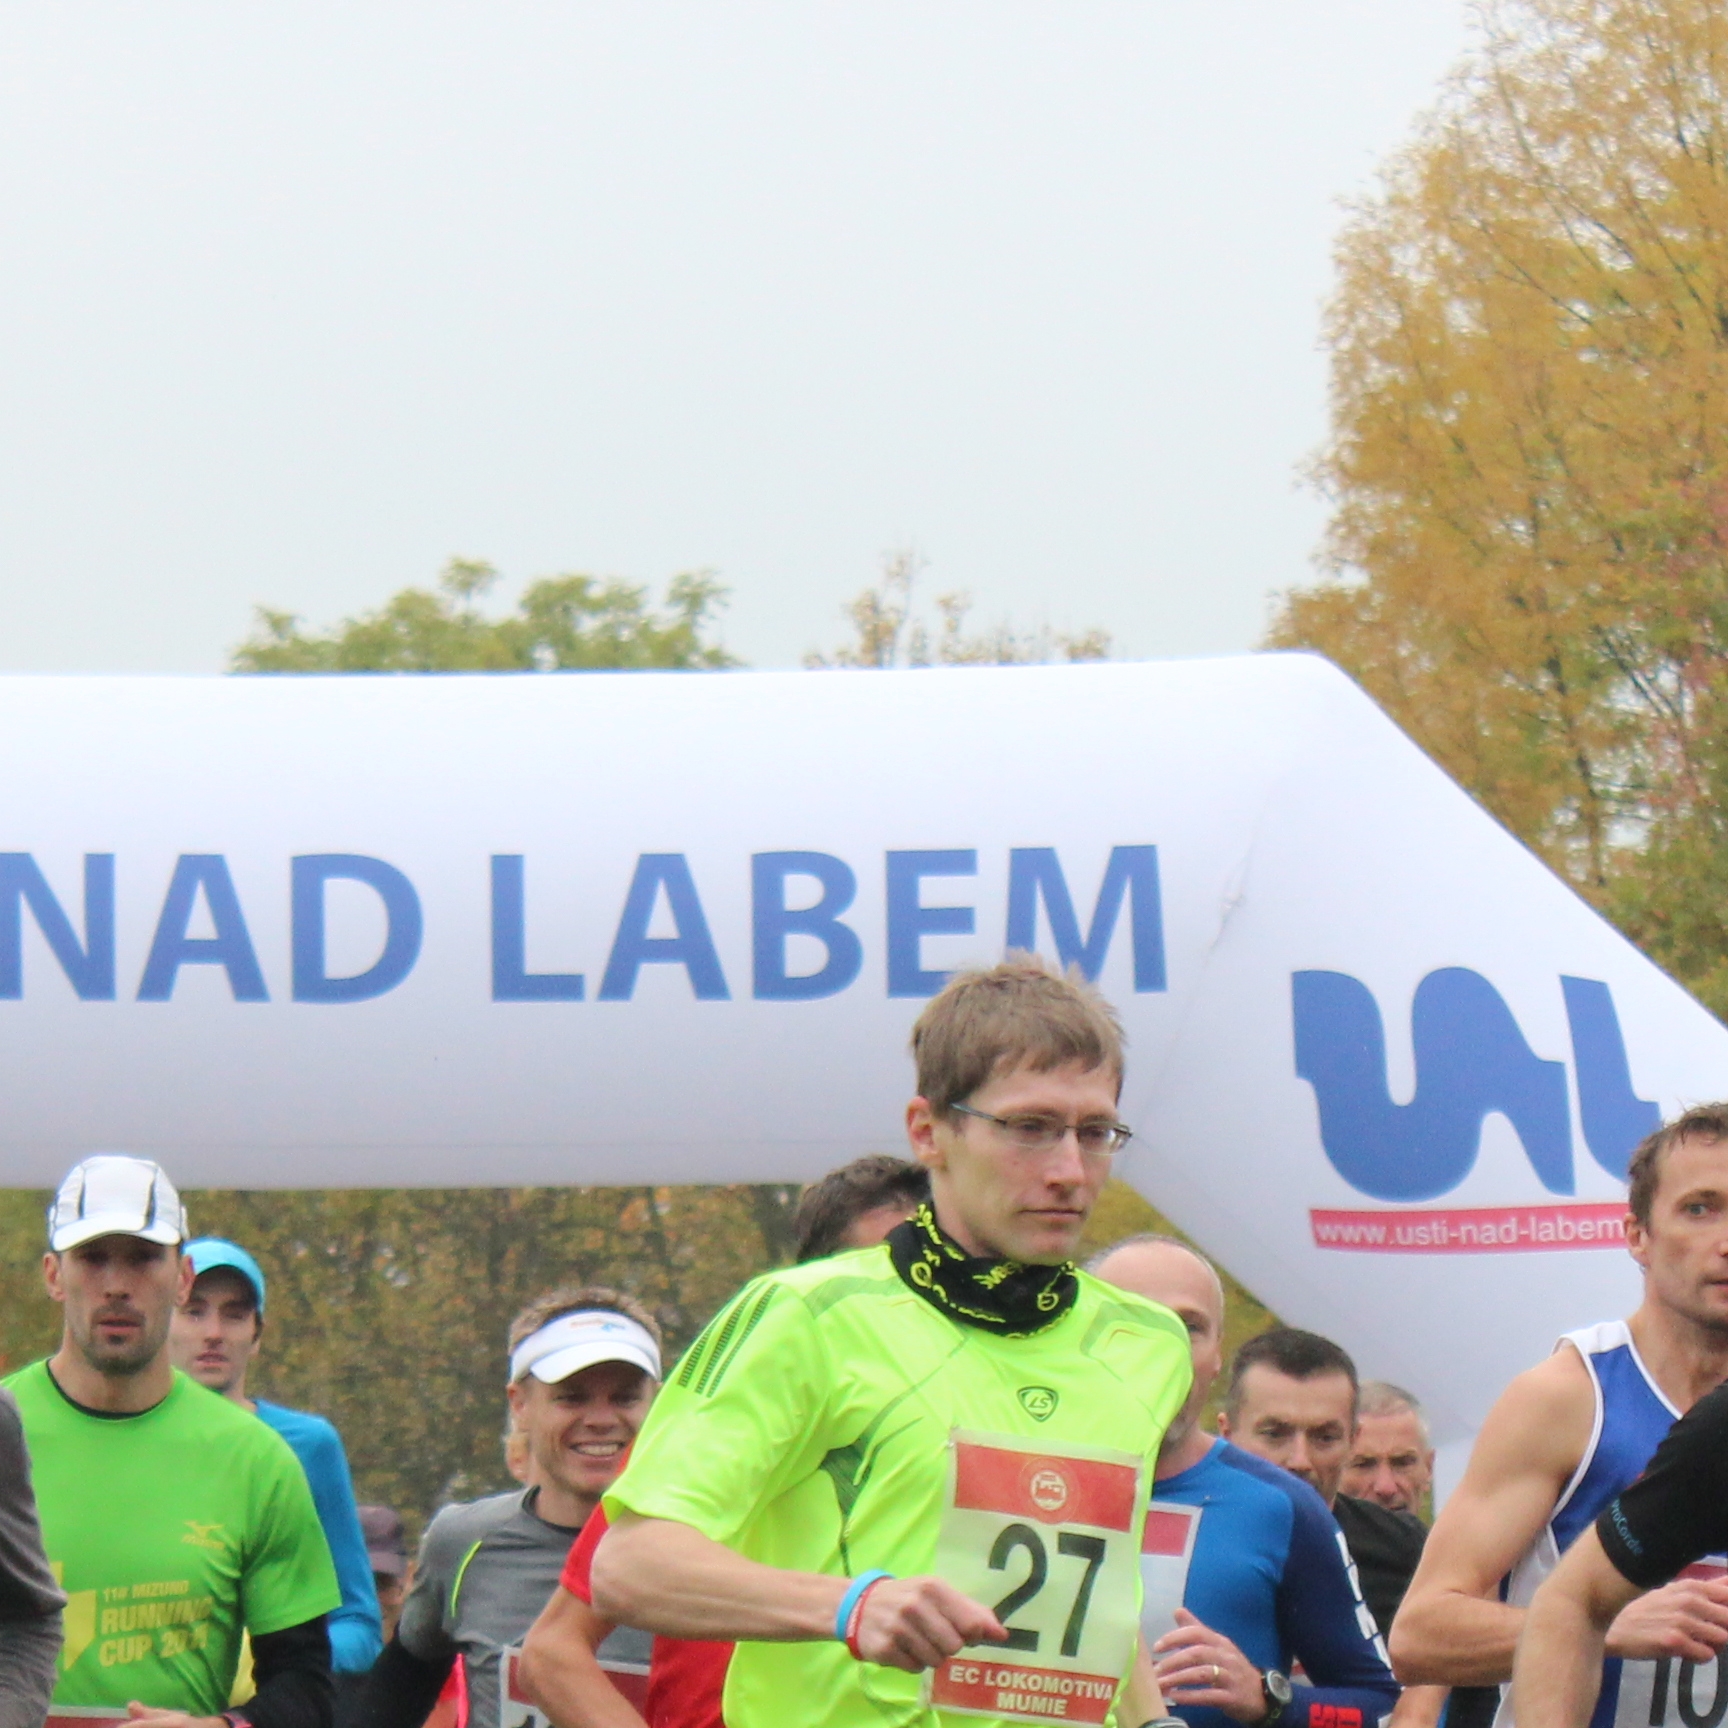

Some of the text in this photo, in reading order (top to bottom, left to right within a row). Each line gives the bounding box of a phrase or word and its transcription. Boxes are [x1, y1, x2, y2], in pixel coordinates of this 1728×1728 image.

[490, 844, 1168, 1003] LABEM
[965, 1523, 1107, 1659] 27
[98, 1633, 153, 1668] CUP
[948, 1665, 1114, 1702] EC LOKOMOTIVA
[996, 1691, 1068, 1716] MUMIE
